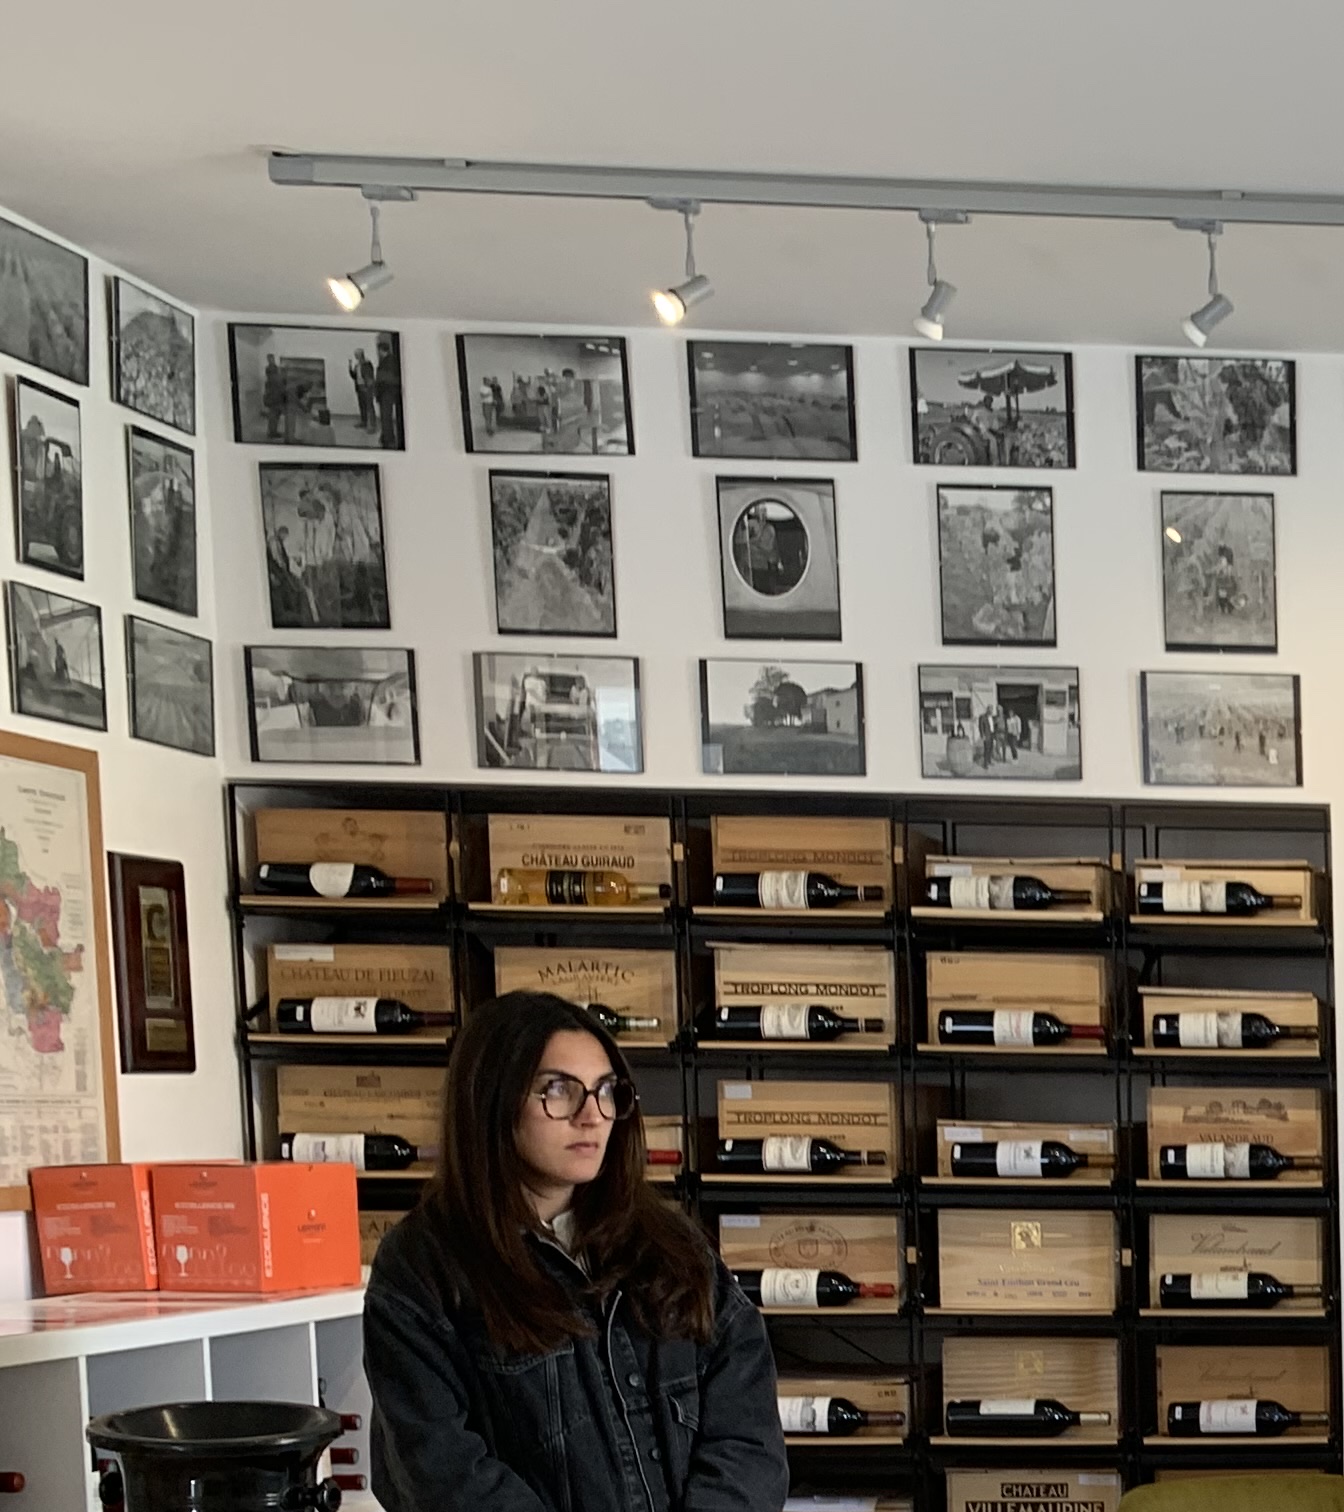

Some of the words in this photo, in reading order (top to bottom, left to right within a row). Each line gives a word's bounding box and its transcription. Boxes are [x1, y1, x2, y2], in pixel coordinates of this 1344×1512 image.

[581, 853, 635, 869] GUIRAUD
[813, 852, 874, 864] MONDOT
[537, 959, 635, 984] MALARTIC
[733, 983, 809, 996] TROPLONG
[815, 984, 879, 997] MONDOT
[735, 1112, 811, 1125] TROPLONG
[817, 1112, 879, 1126] MONDOT
[1002, 1484, 1068, 1498] CHATEAU
